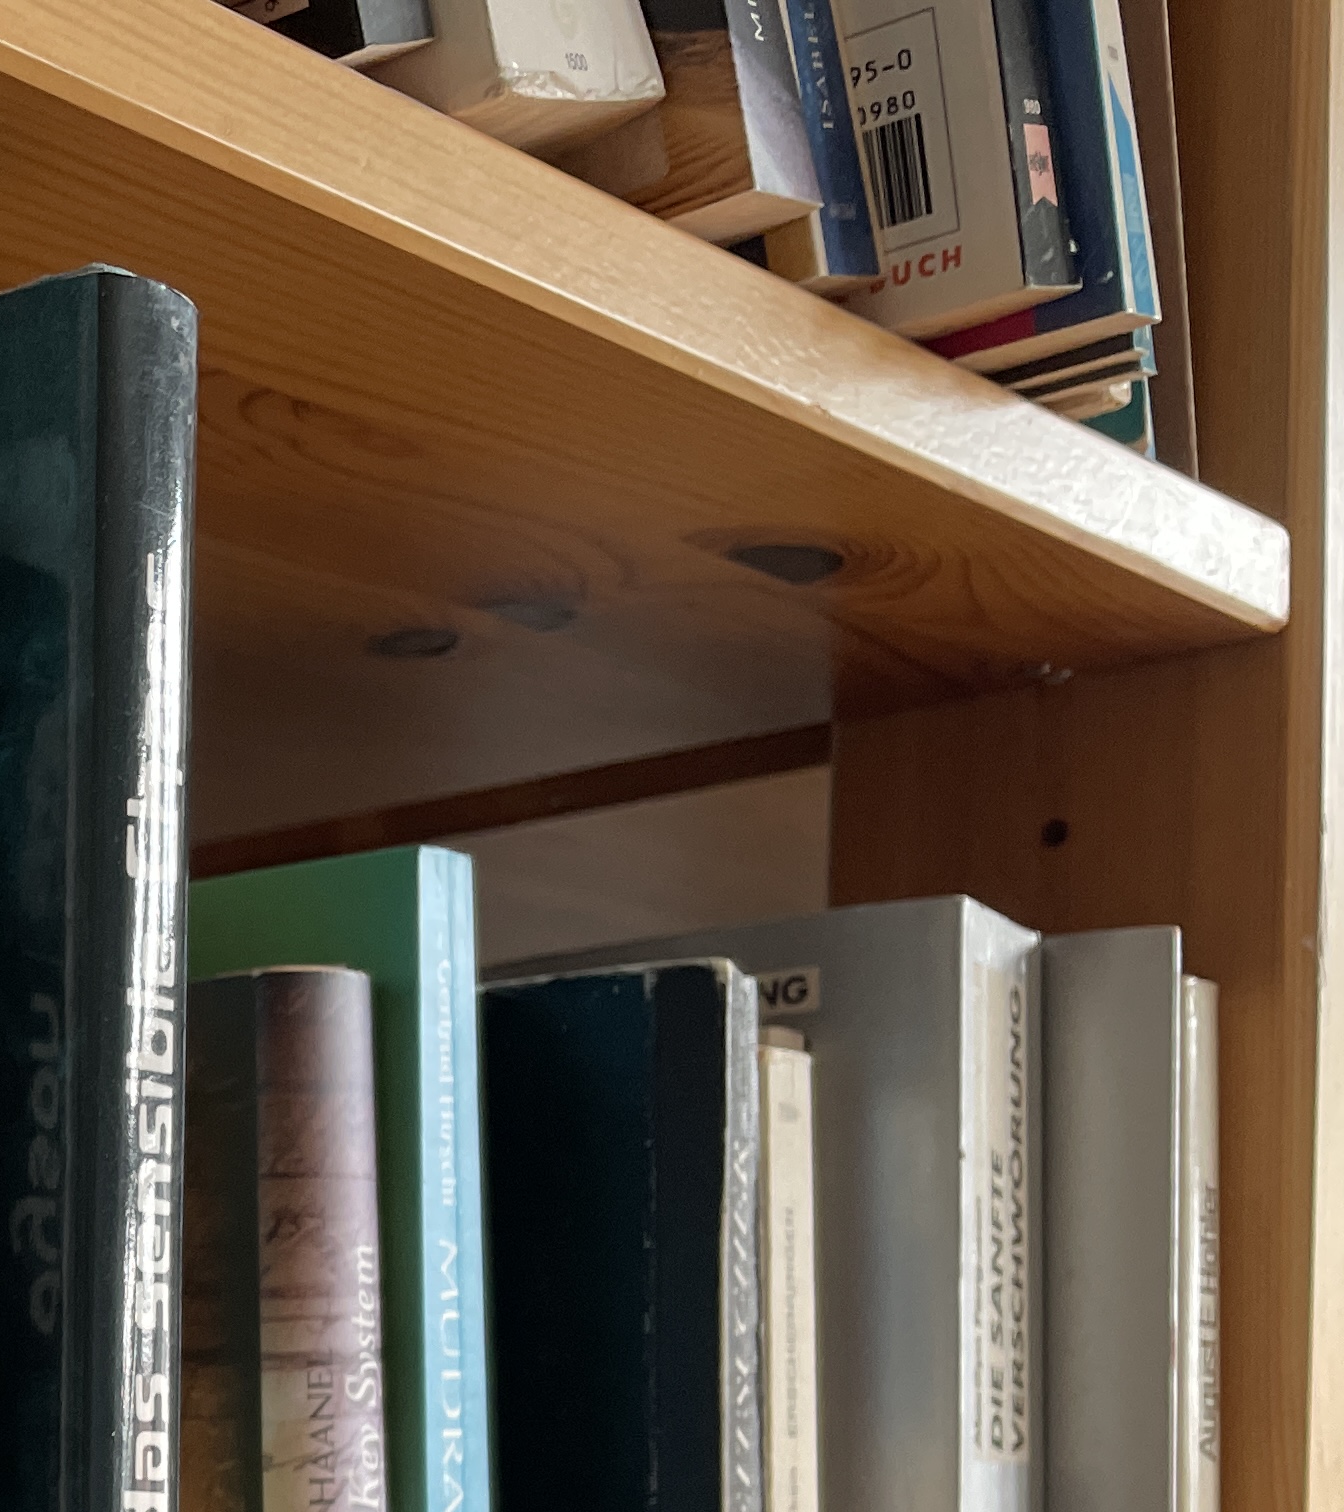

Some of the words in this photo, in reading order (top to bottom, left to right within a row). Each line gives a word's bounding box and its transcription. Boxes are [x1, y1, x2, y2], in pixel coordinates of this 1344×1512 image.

[990, 1150, 1004, 1348] SANFTE
[1008, 985, 1025, 1454] VERSCHWÖRUNG
[344, 1241, 379, 1405] System
[306, 1349, 336, 1505] HAANEL
[347, 1421, 383, 1509] Key
[990, 1365, 1004, 1451] DIE
